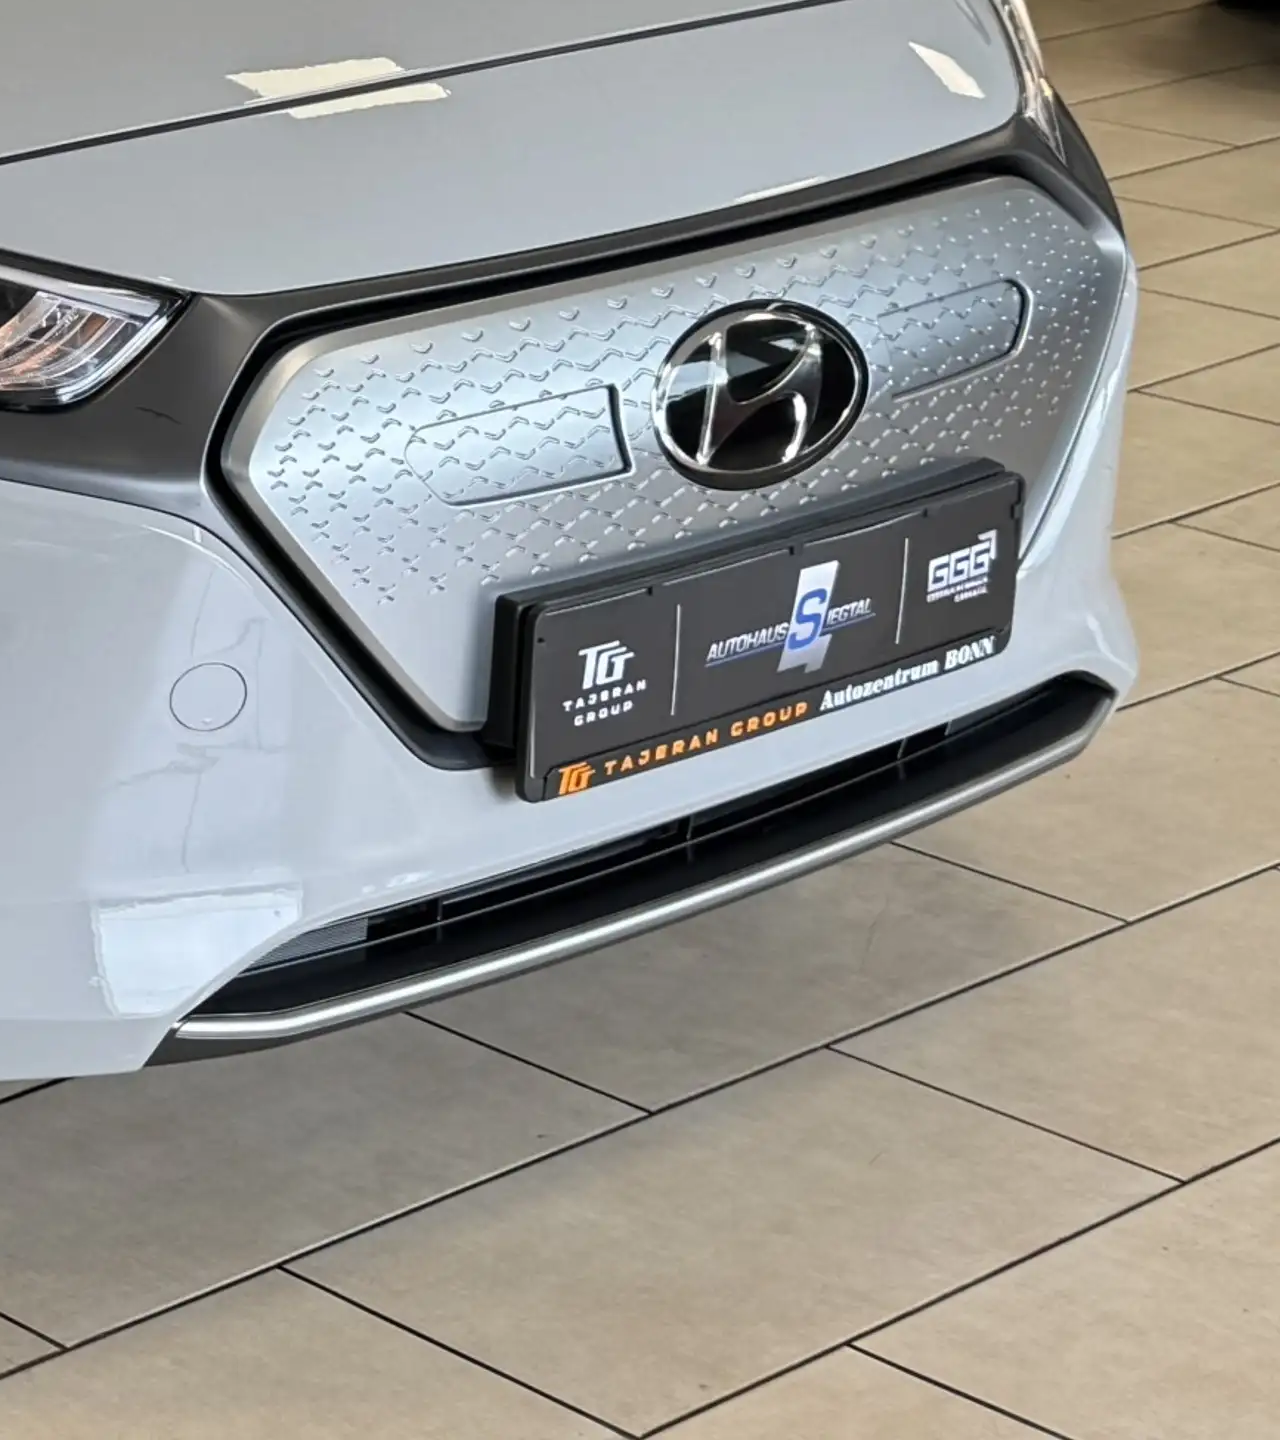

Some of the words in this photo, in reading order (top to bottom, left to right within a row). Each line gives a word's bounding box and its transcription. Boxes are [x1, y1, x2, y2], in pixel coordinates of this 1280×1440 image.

[926, 537, 993, 593] GGG
[706, 622, 789, 662] AUTOHAUS
[730, 701, 809, 738] GROUP
[819, 659, 940, 712] Autozentrum
[943, 634, 998, 671] BONN
[573, 700, 634, 727] GROUP
